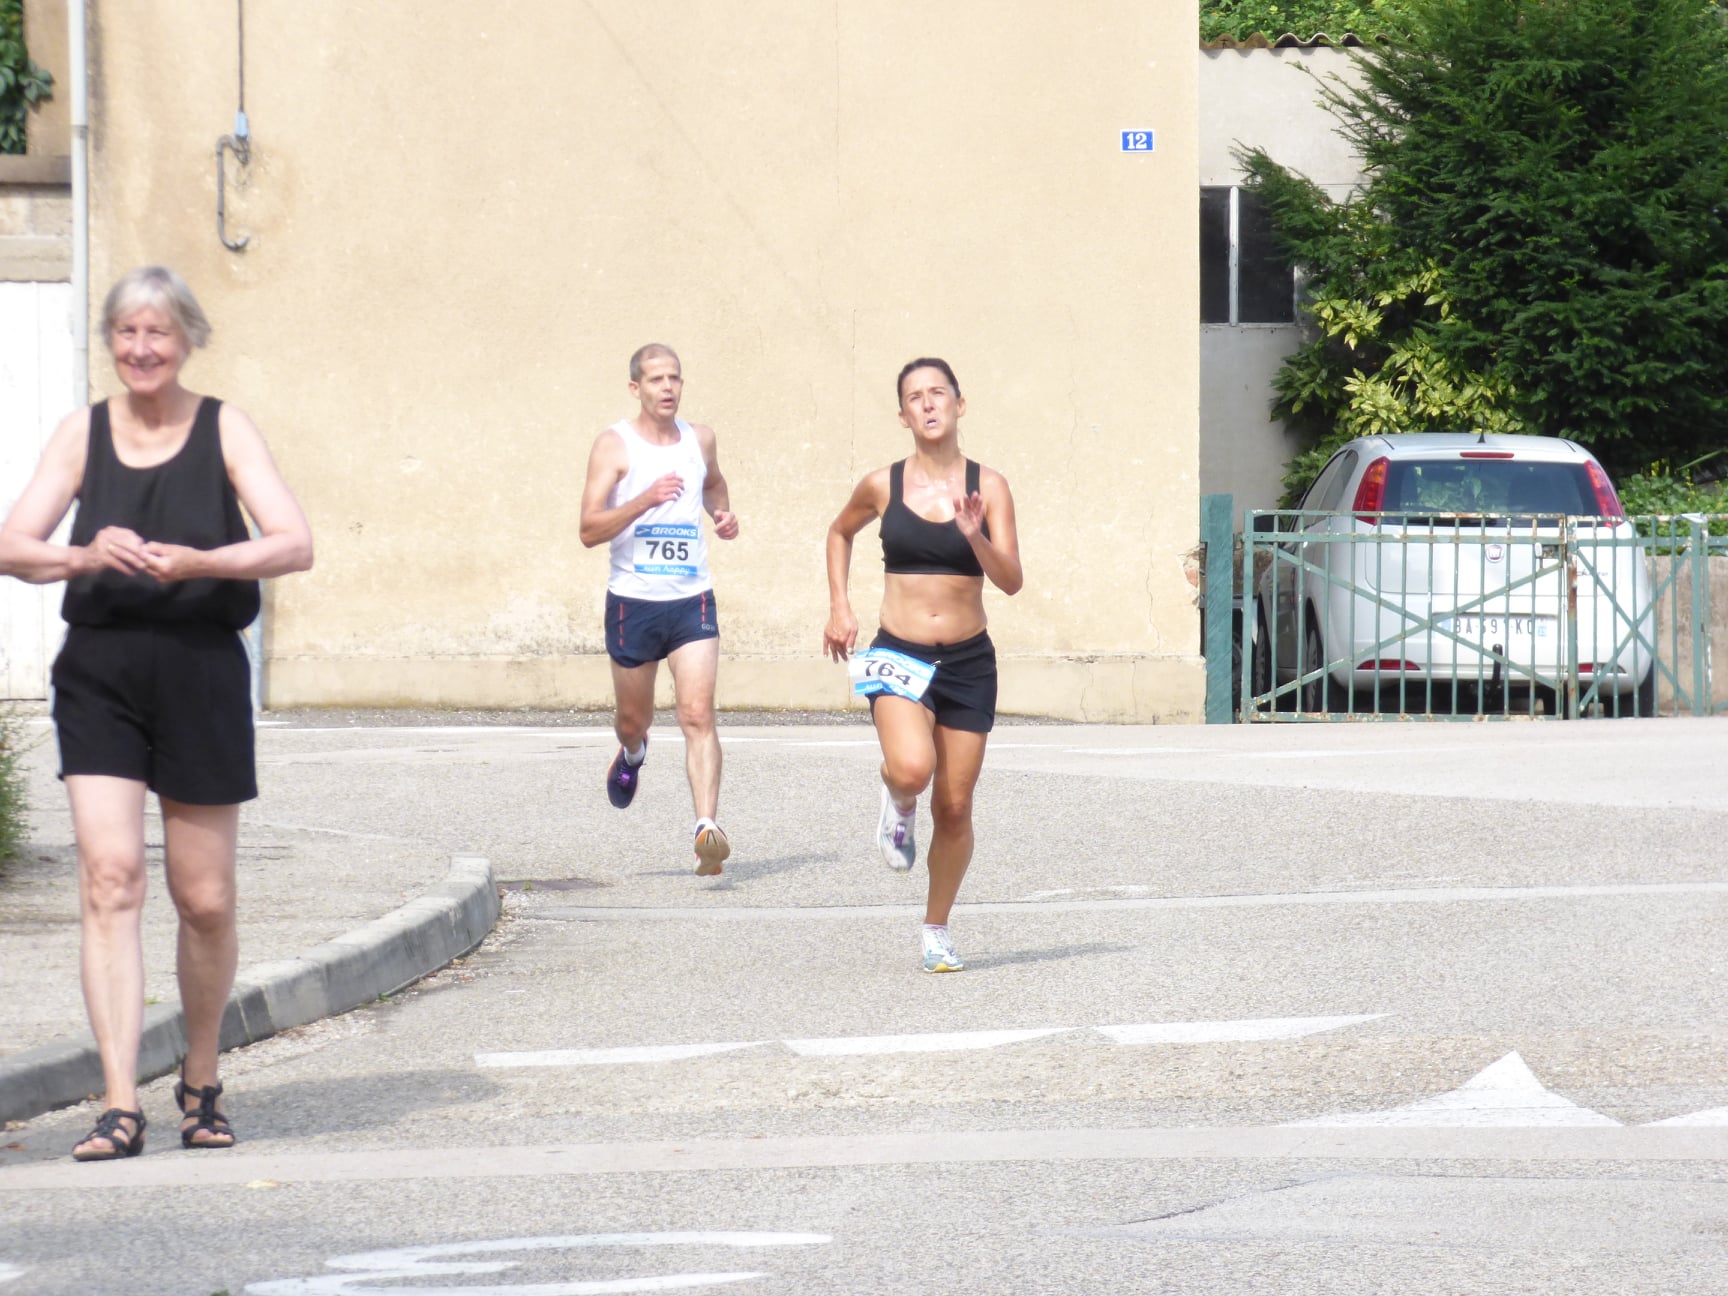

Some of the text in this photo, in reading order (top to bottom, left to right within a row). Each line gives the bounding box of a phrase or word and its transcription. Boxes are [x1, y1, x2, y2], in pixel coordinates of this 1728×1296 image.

[1127, 132, 1147, 150] 12
[651, 526, 696, 537] BROOKS
[646, 540, 689, 561] 765
[663, 564, 690, 576] happy
[864, 659, 912, 686] 764
